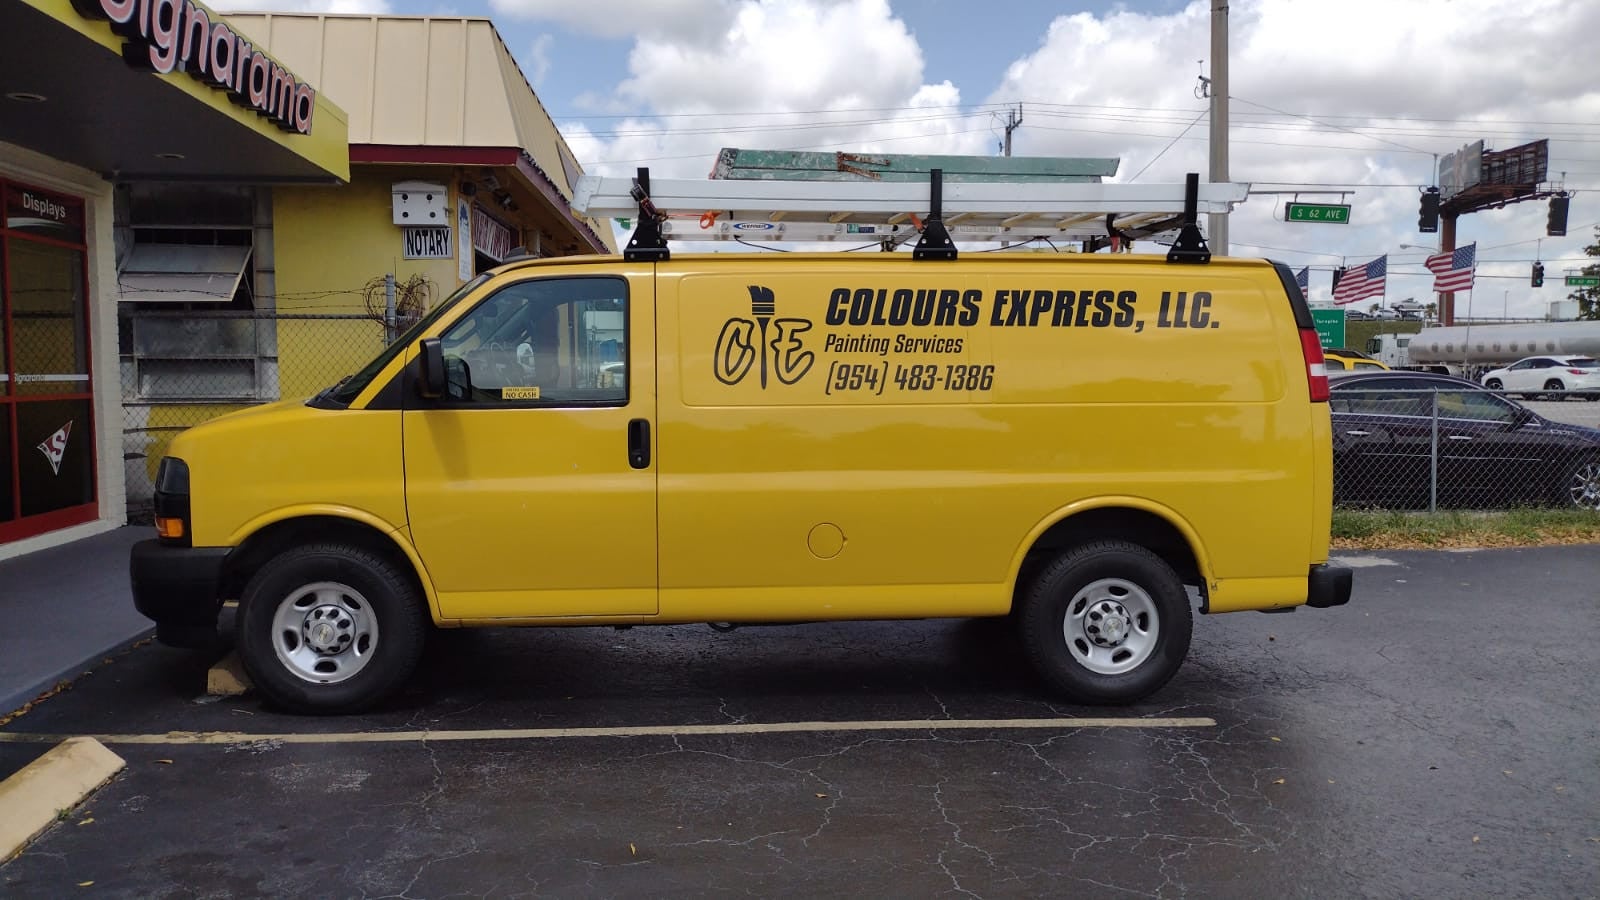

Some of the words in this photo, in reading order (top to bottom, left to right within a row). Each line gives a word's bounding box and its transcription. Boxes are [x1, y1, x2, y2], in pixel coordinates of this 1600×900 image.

[23, 192, 66, 220] Displays
[1297, 208, 1304, 218] S
[1309, 209, 1320, 218] 62
[1325, 210, 1342, 219] AVE
[406, 229, 450, 256] NOTARY
[825, 288, 983, 327] COLOURS
[990, 290, 1145, 333] EXPRESS,
[1157, 291, 1220, 329] LLC.
[824, 333, 890, 357] Painting
[894, 334, 964, 354] Services
[825, 360, 889, 396] (954)
[894, 364, 995, 391] 483-1386
